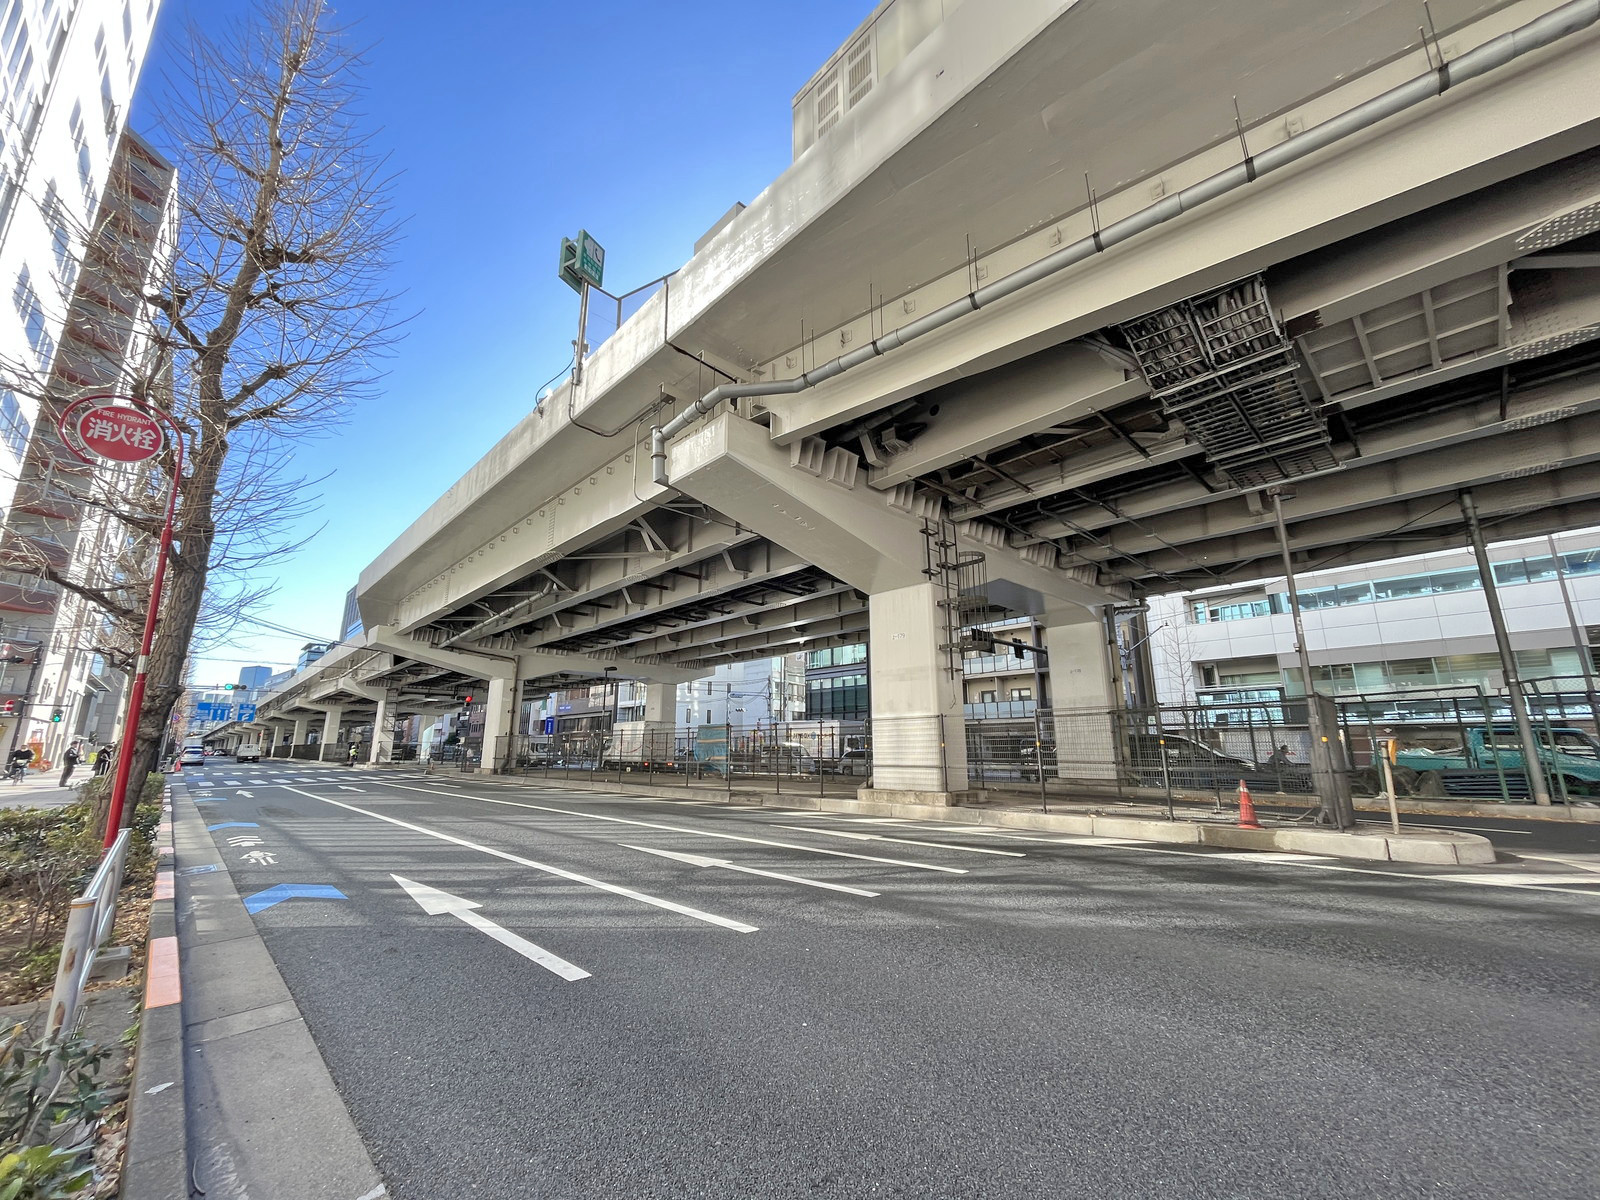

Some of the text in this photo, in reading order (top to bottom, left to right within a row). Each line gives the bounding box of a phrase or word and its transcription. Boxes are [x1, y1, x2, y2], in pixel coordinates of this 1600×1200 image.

[98, 409, 152, 426] FIRE HYDRANT
[86, 417, 157, 451] 消火栓
